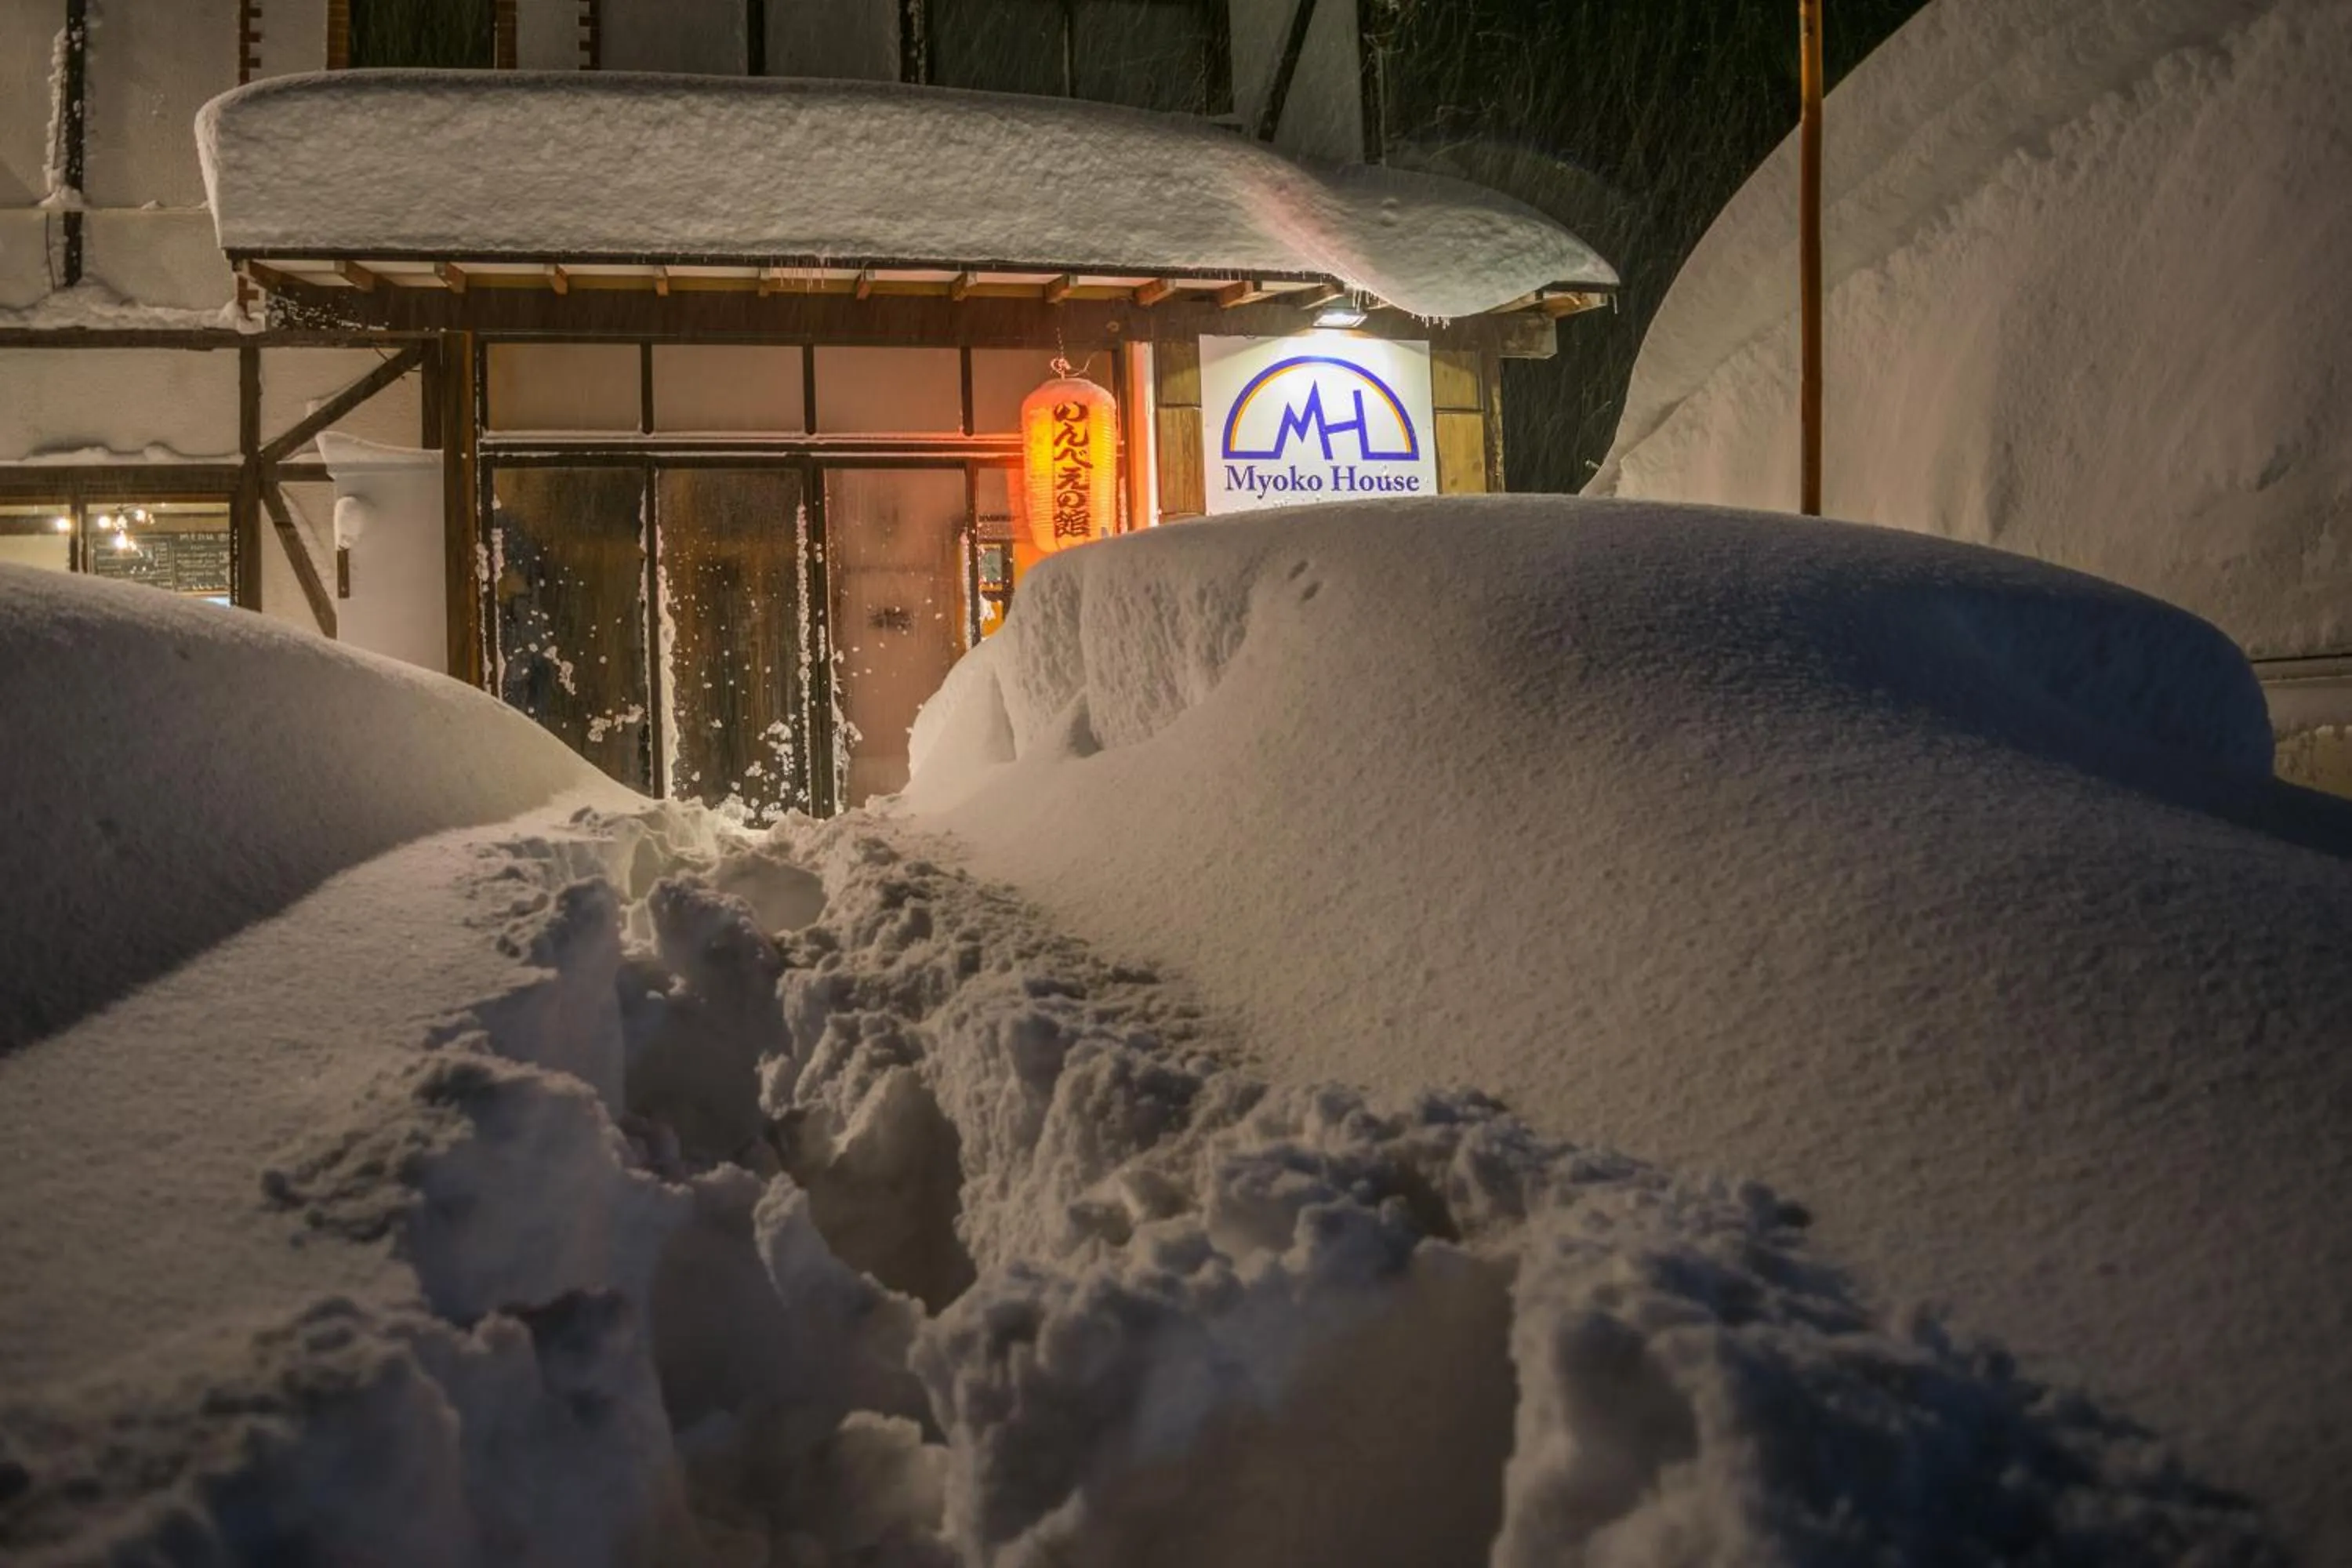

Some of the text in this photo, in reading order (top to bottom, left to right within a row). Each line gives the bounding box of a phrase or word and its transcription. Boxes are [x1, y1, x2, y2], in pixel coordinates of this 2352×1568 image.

[1053, 401, 1094, 538] のんべえの館
[1224, 465, 1420, 499] Myoko House
